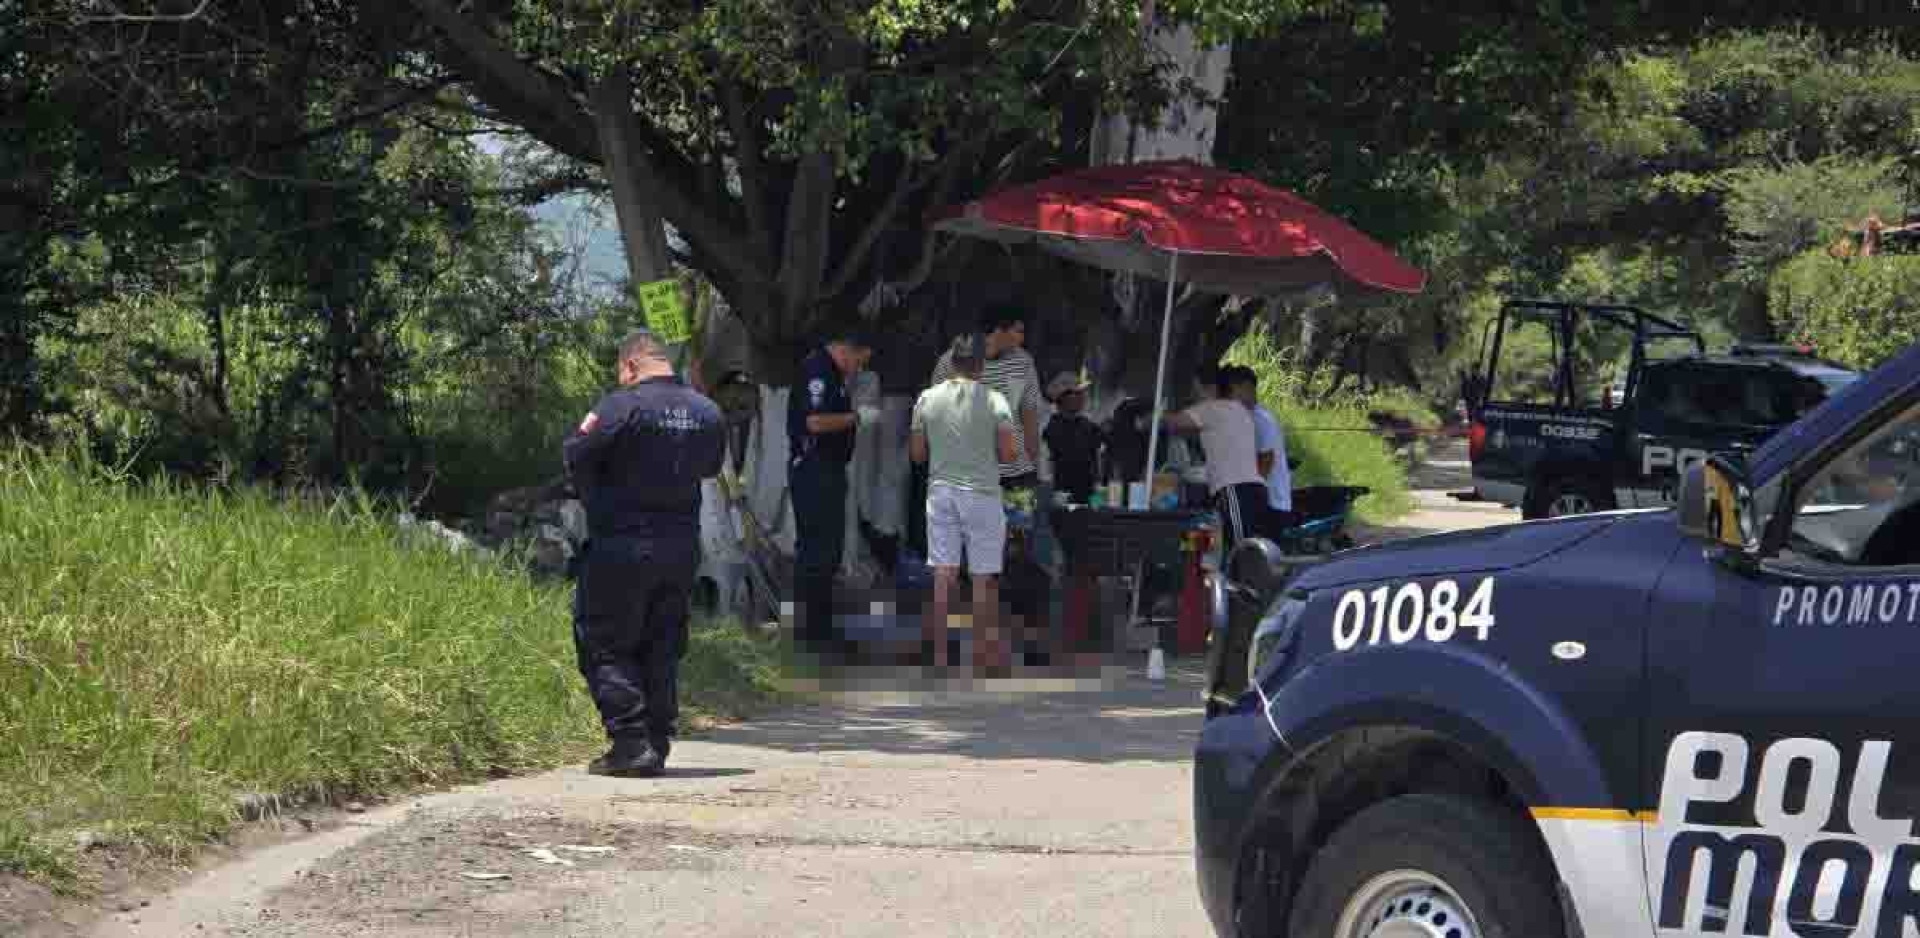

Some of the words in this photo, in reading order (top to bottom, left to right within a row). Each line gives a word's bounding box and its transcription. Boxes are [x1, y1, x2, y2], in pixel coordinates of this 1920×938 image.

[1332, 576, 1495, 651] 01084
[1773, 583, 1920, 625] PROMOT
[1659, 731, 1913, 838] POL
